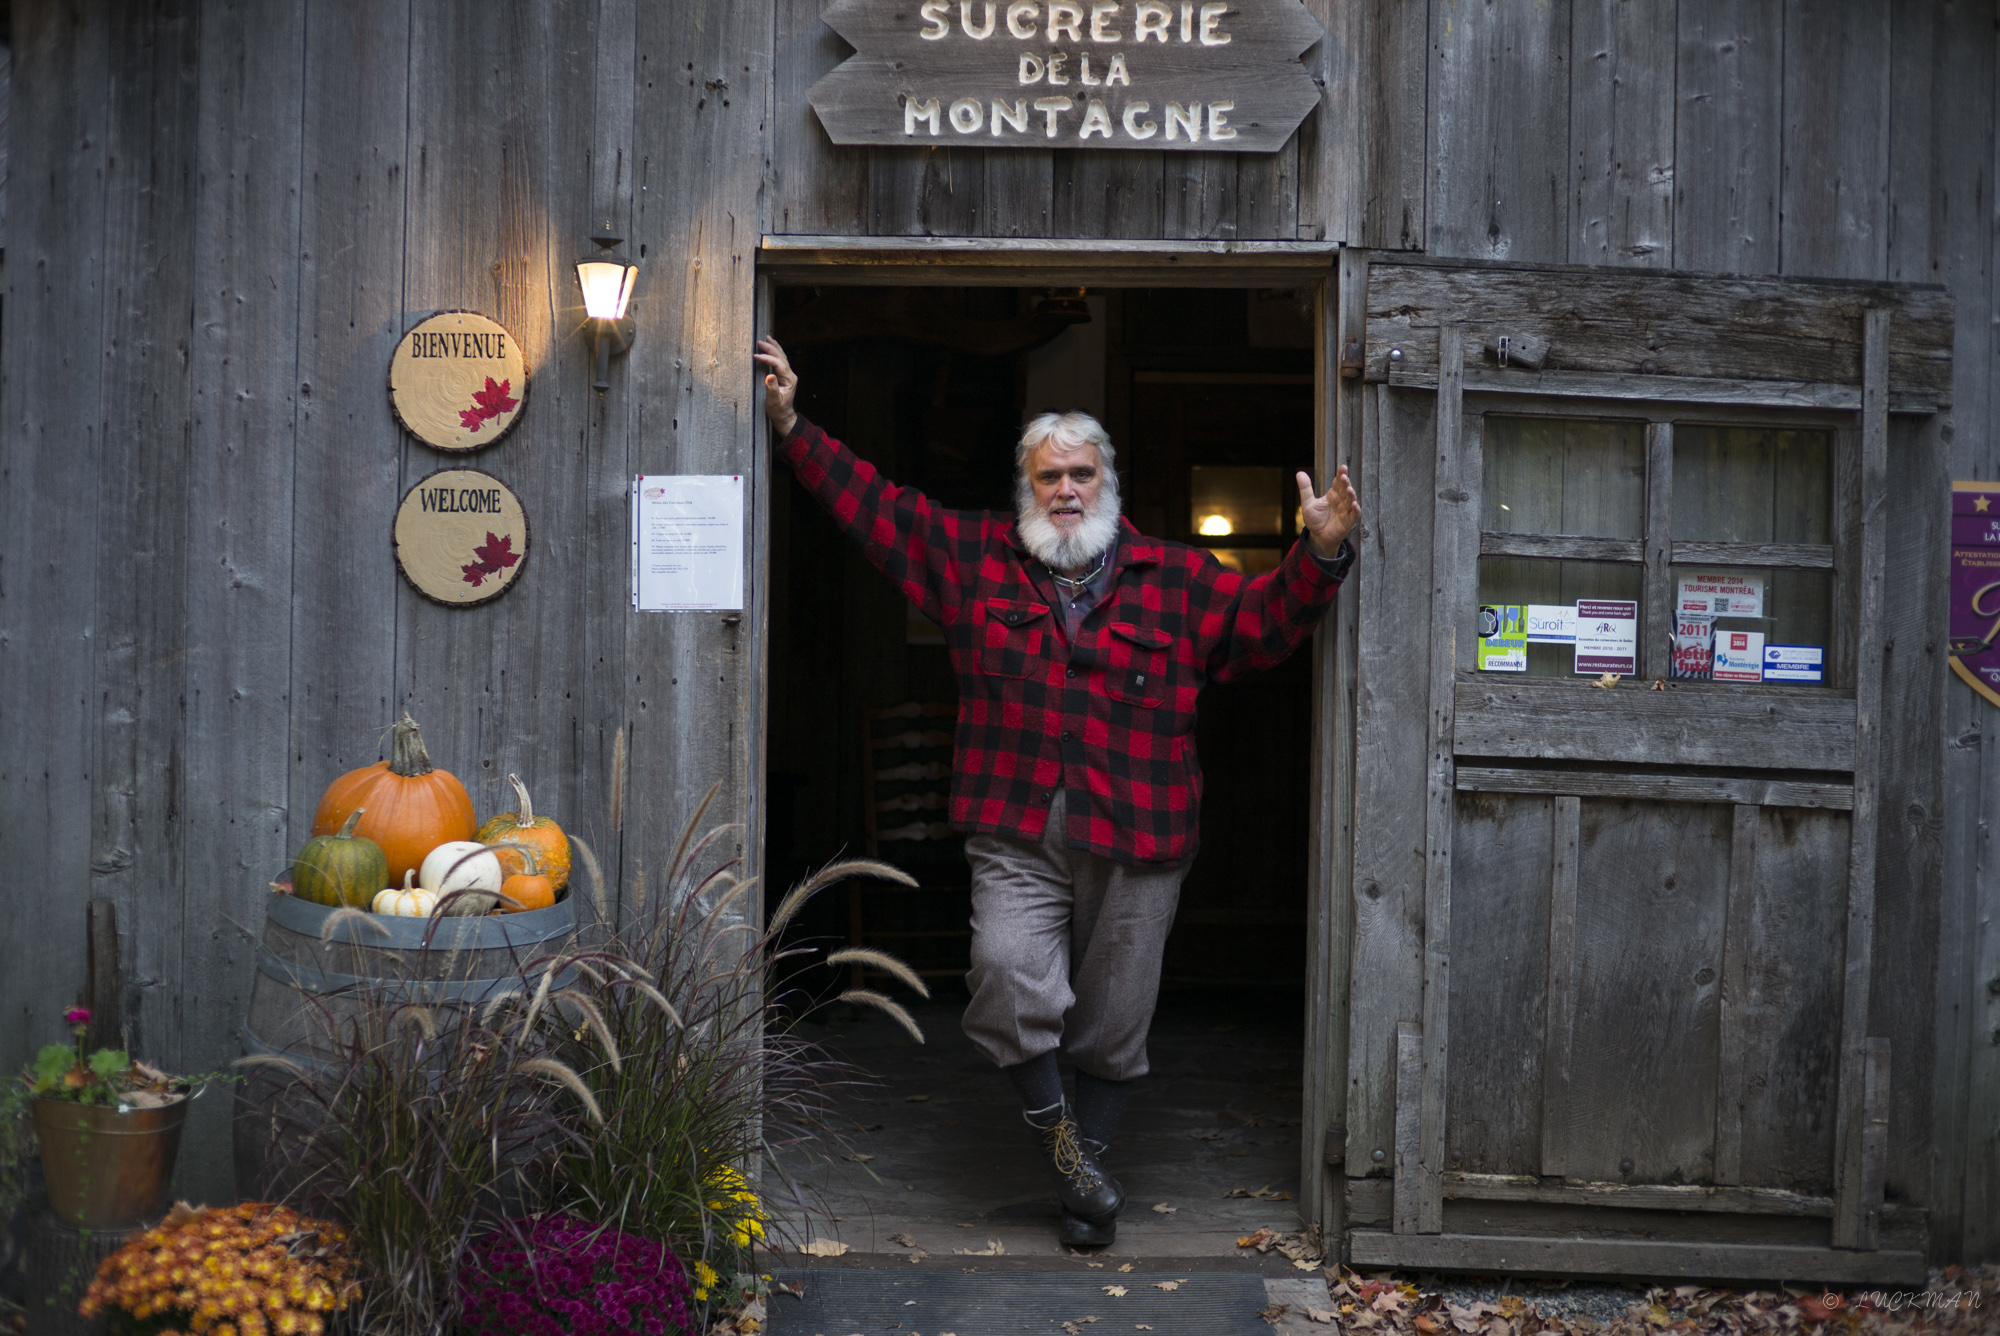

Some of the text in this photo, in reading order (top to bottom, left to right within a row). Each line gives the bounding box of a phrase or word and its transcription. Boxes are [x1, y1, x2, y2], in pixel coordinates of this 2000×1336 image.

[919, 0, 1232, 46] SUCRERIE
[1019, 52, 1131, 87] DE LA
[904, 96, 1237, 142] MONTAGNE
[411, 332, 506, 360] BIENVENUE
[420, 488, 502, 514] WELCOME
[1697, 575, 1744, 585] MEMBRE 2014
[1684, 584, 1756, 596] TOURISME MONTRÉAL
[1679, 624, 1708, 636] 2011
[1485, 638, 1525, 648] DEBEUR
[1673, 647, 1712, 662] petit
[1488, 660, 1524, 668] RECOMMANDÉ
[1678, 660, 1711, 672] futé
[1728, 660, 1760, 670] Montérégie
